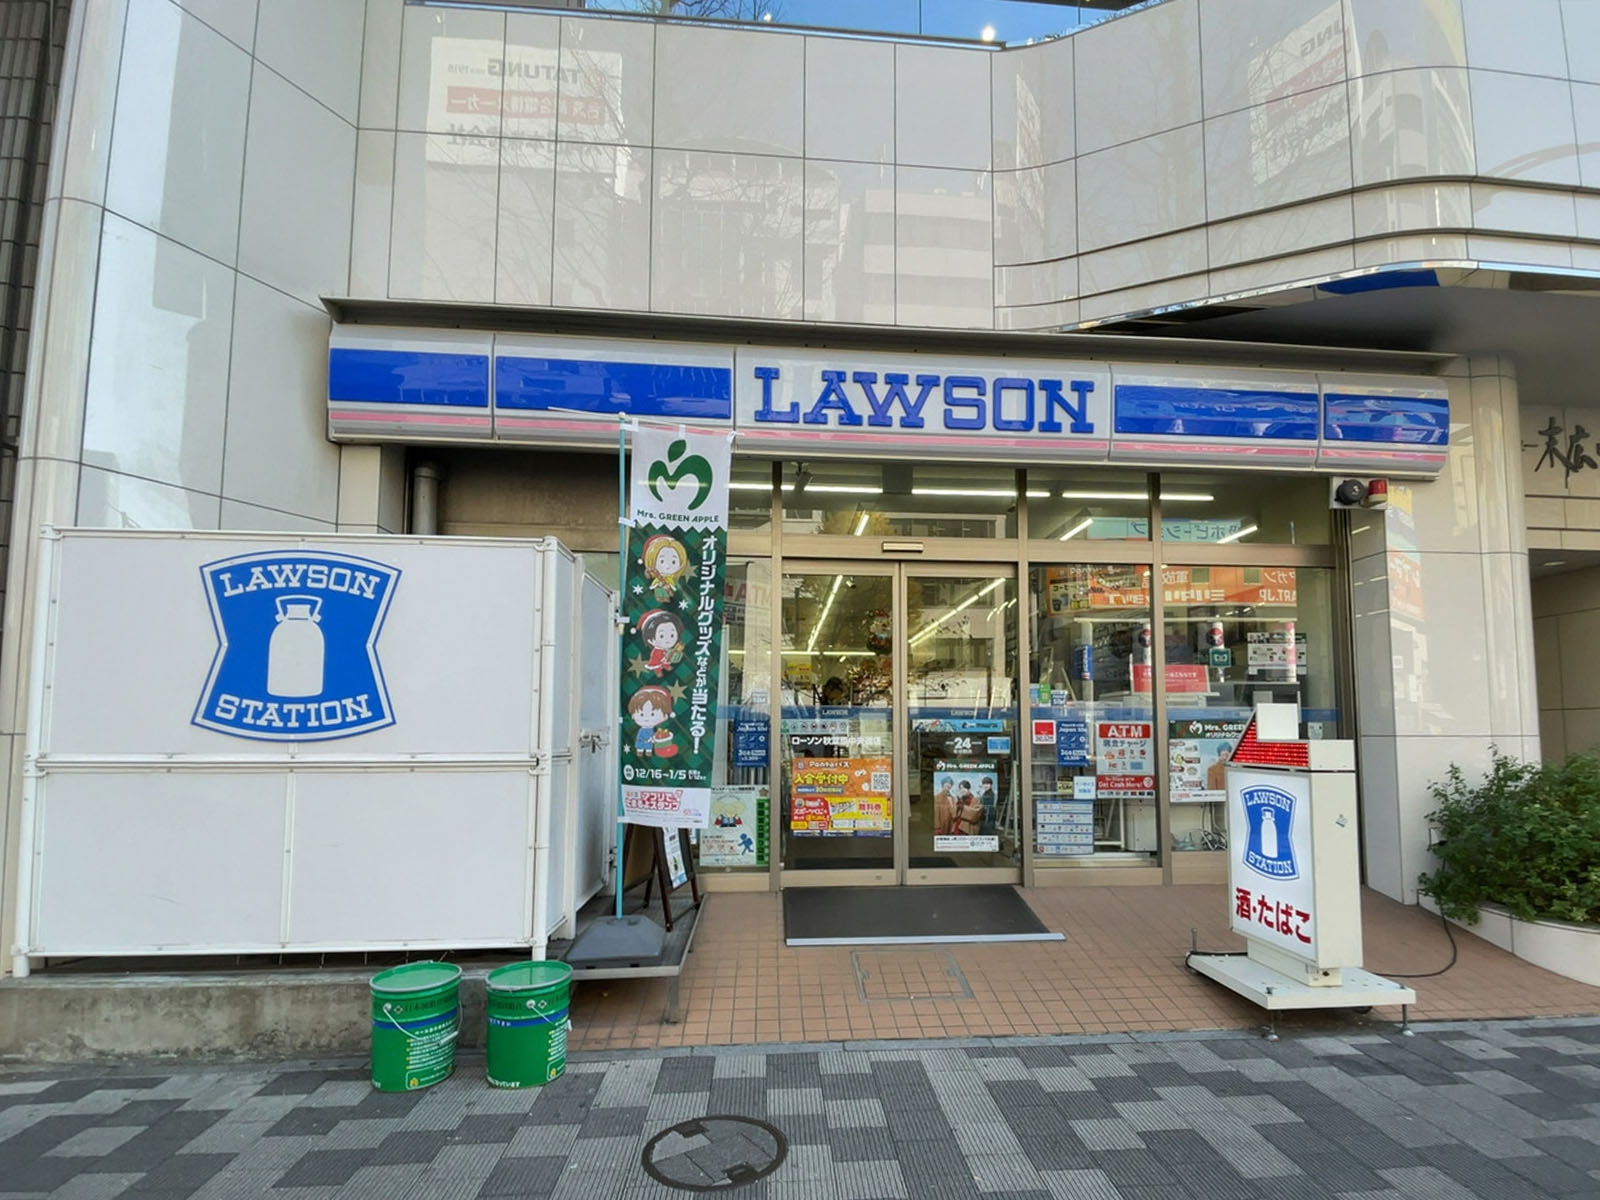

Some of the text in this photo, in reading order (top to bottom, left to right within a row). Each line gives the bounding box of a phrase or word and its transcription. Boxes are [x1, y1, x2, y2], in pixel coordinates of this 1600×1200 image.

[755, 366, 1095, 433] LAWSON
[636, 509, 720, 524] Mrs. GREEN APPLE
[220, 564, 380, 600] LAWSON
[689, 536, 718, 754] オリジナルグッズなどが当たる！
[216, 693, 372, 728] STATION
[1107, 725, 1143, 738] ATM
[1204, 724, 1221, 732] Mrs.
[954, 736, 972, 749] 24
[958, 762, 978, 770] GREEN
[1244, 790, 1291, 813] LAWSON
[1247, 850, 1293, 875] STATION
[1235, 886, 1312, 945] 酒・たばこ
